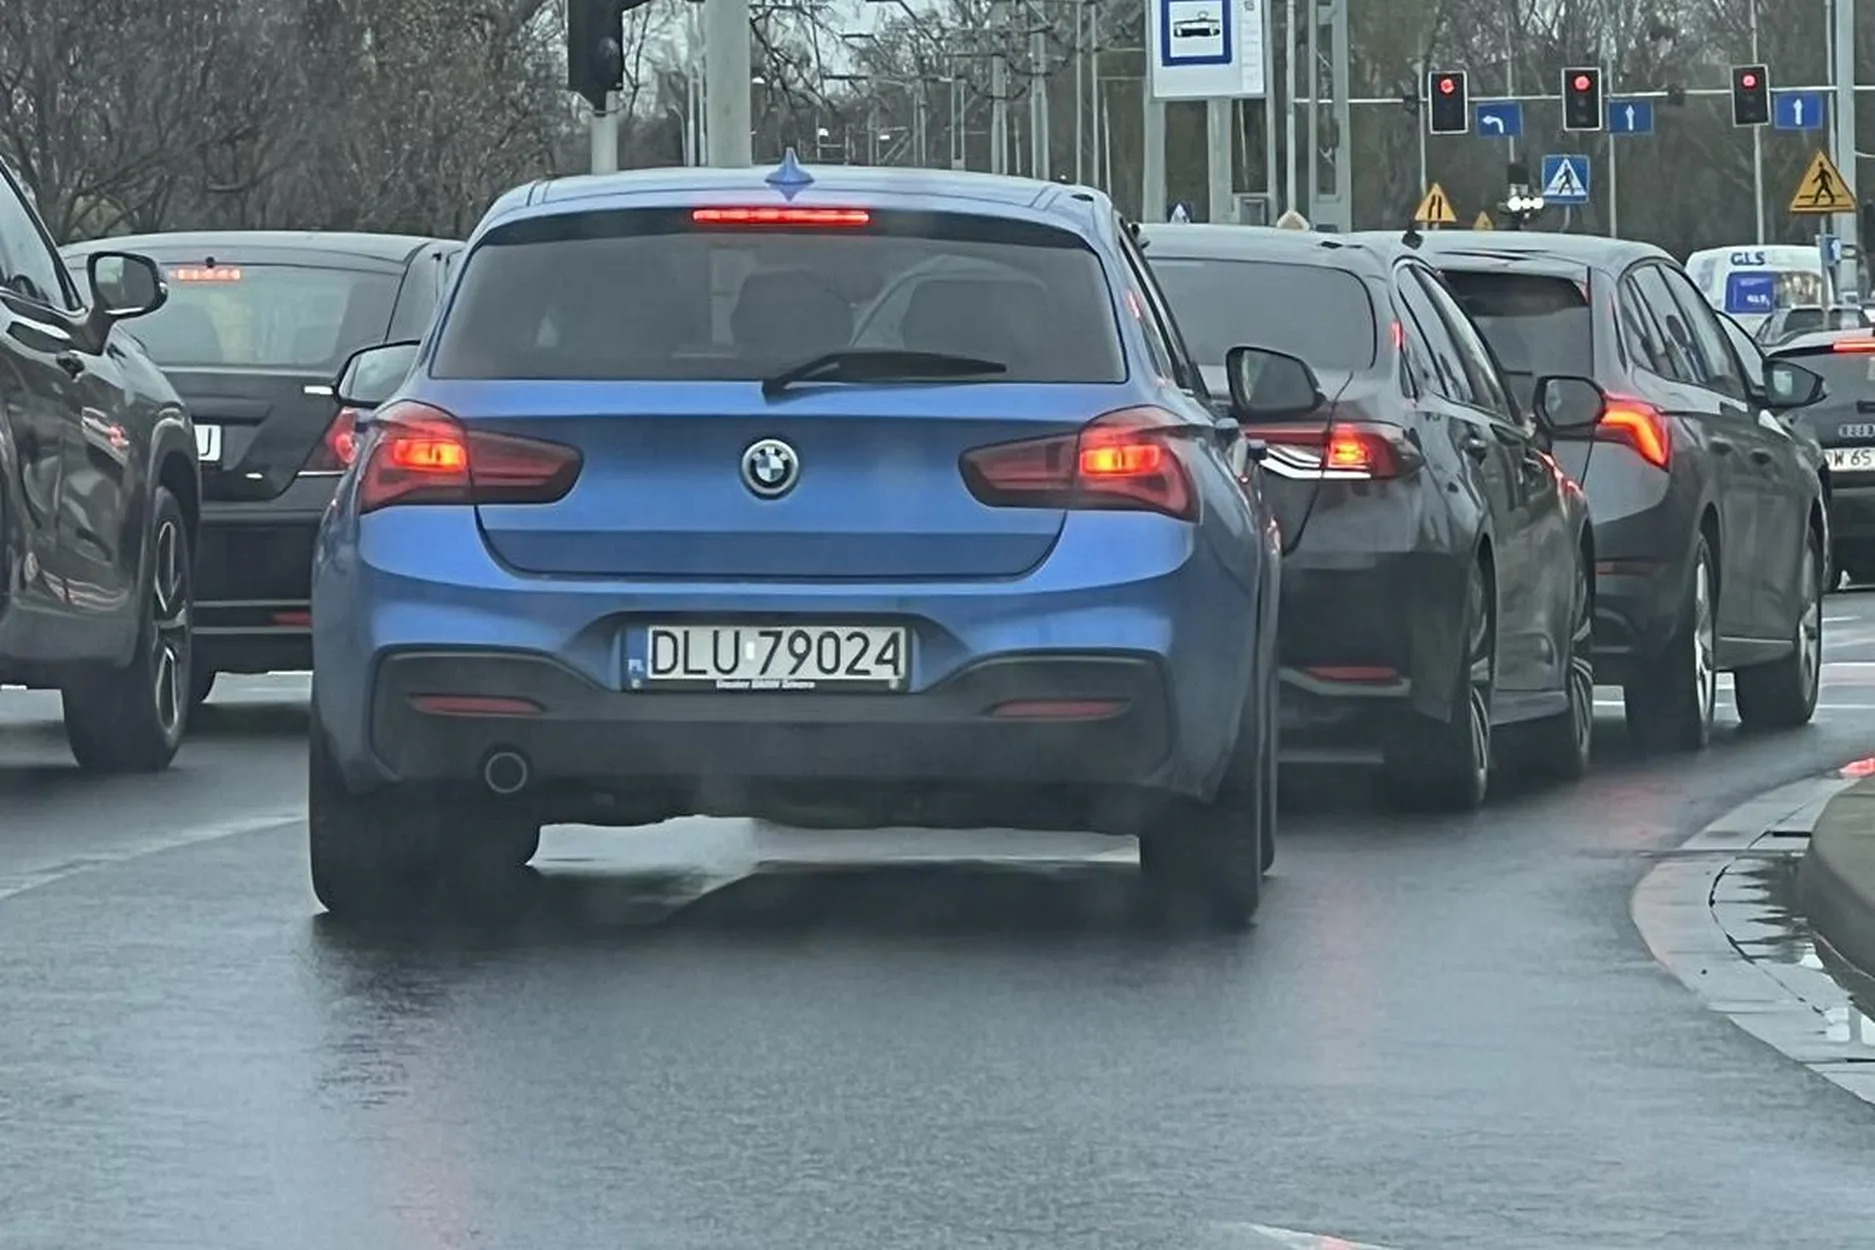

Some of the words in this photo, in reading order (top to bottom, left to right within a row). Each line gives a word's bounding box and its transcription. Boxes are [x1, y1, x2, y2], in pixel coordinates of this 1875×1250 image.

[1731, 251, 1765, 266] GLS
[652, 630, 740, 675] DLU
[758, 630, 900, 676] 79024
